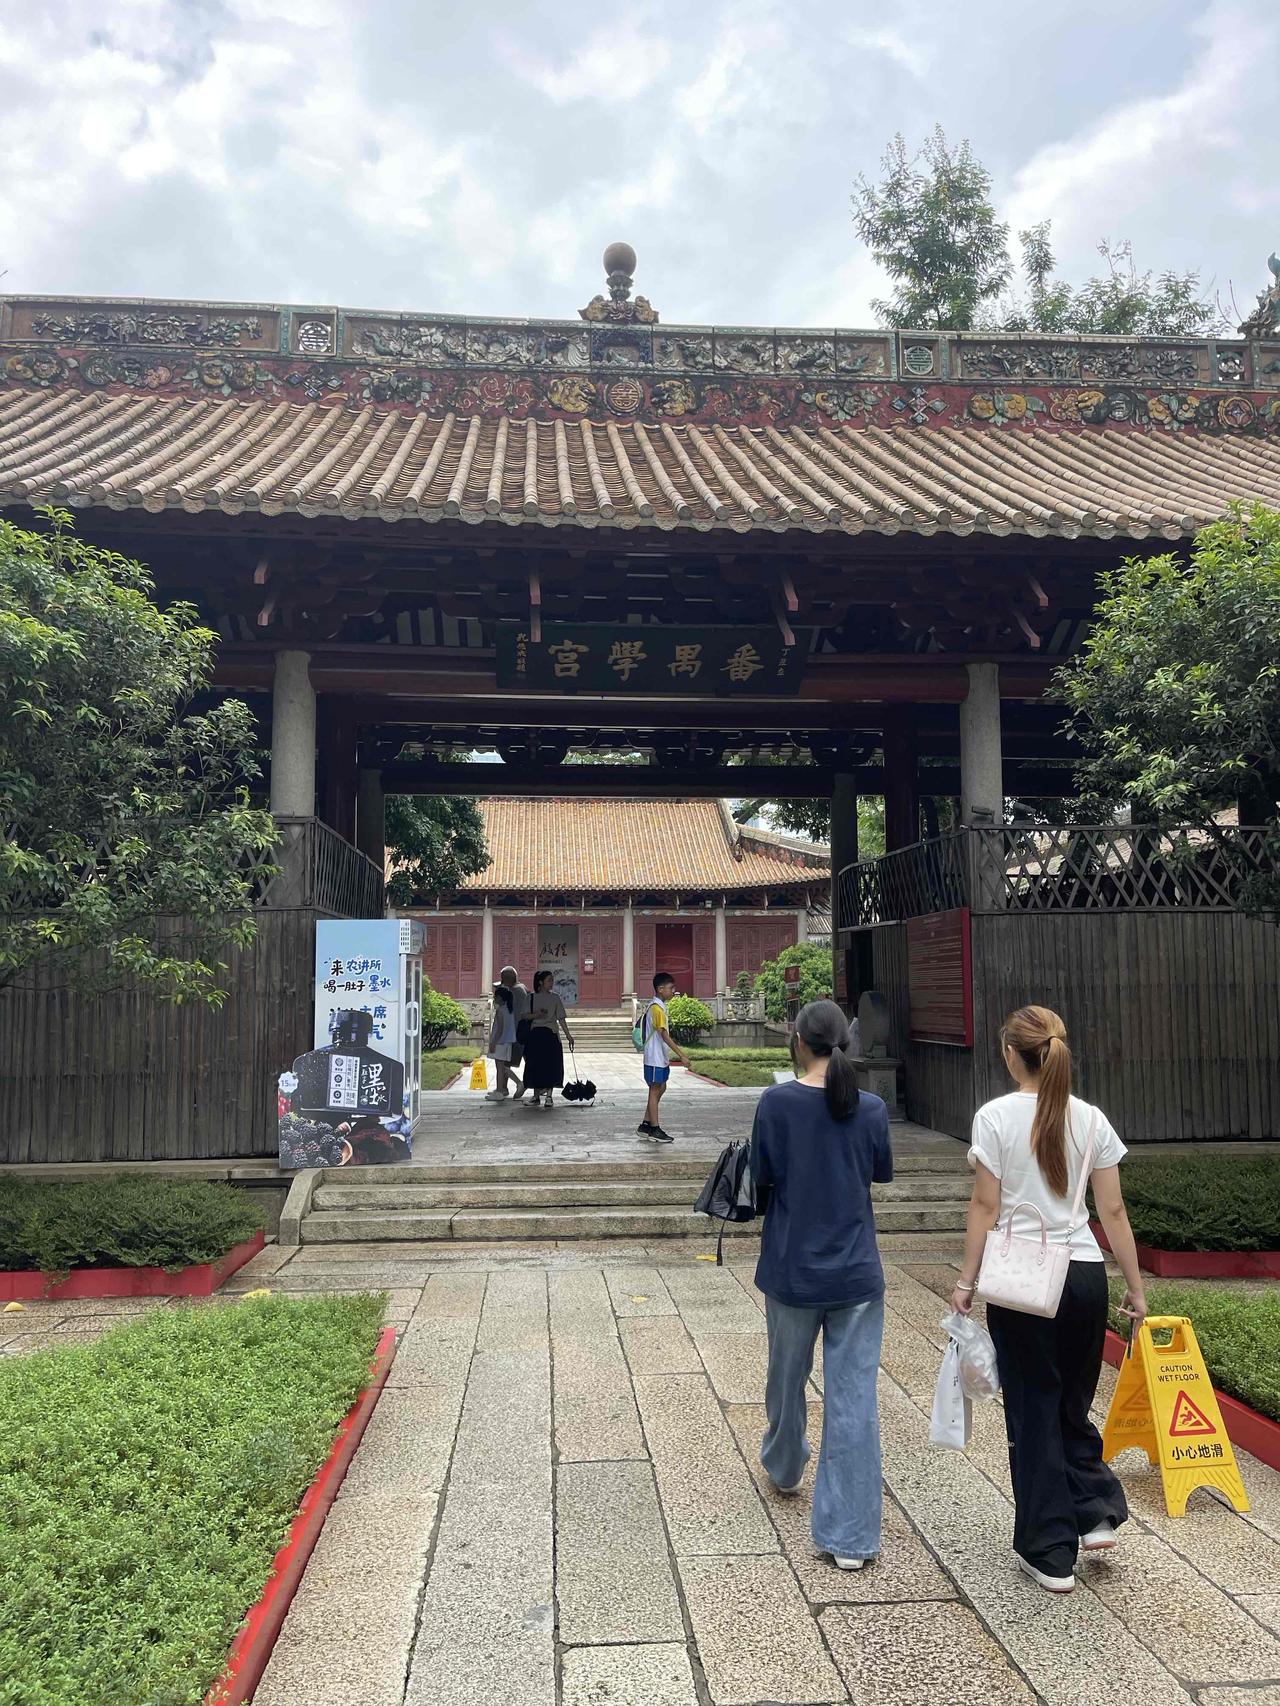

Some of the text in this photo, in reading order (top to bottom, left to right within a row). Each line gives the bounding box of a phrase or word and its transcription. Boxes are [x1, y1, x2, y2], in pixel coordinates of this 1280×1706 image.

[323, 974, 391, 993] 喝一肚子墨水
[1160, 1364, 1193, 1373] CAUTION
[1175, 1373, 1200, 1382] FLOOR
[1172, 1443, 1223, 1461] 小心地滑
